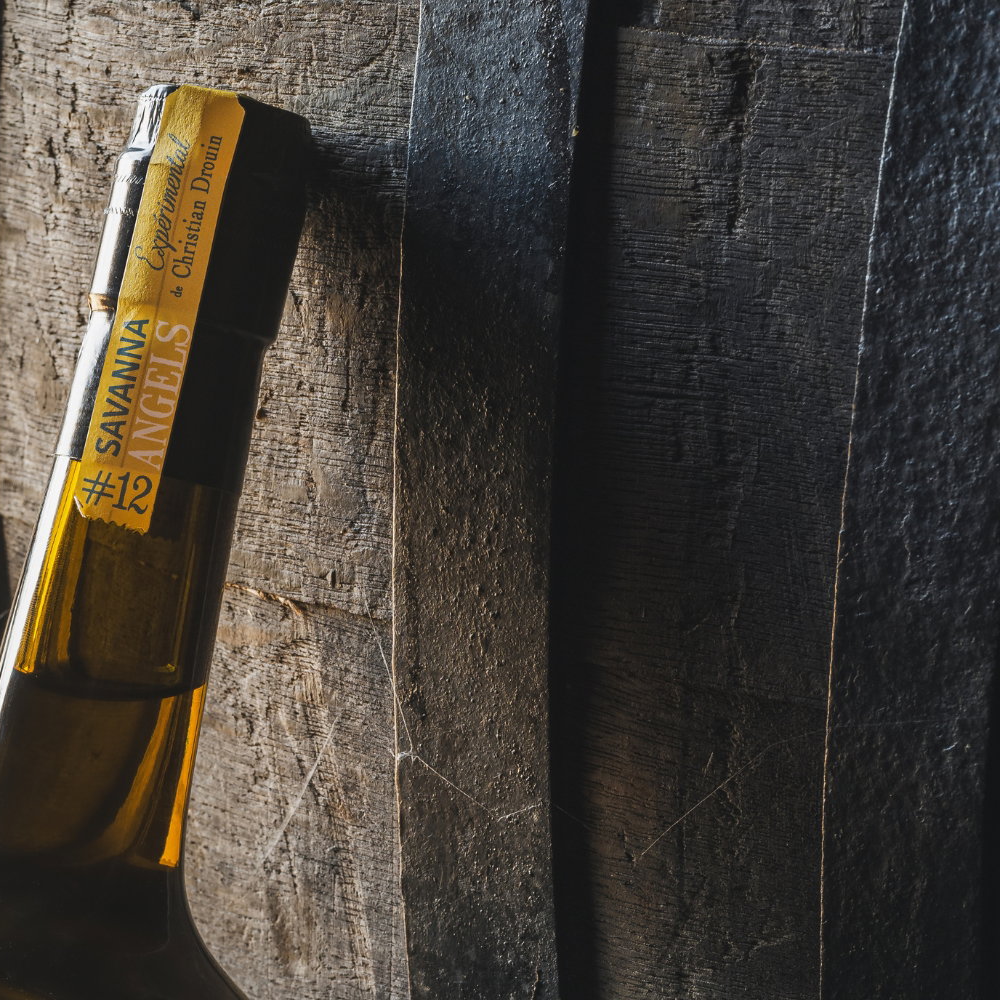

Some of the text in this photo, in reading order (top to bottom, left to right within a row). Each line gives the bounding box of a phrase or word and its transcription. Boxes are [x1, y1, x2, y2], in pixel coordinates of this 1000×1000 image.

[170, 135, 223, 298] de Christian Drouin
[95, 319, 149, 457] SAVANNA
[127, 320, 191, 470] ANGELS
[82, 470, 153, 515] #12
